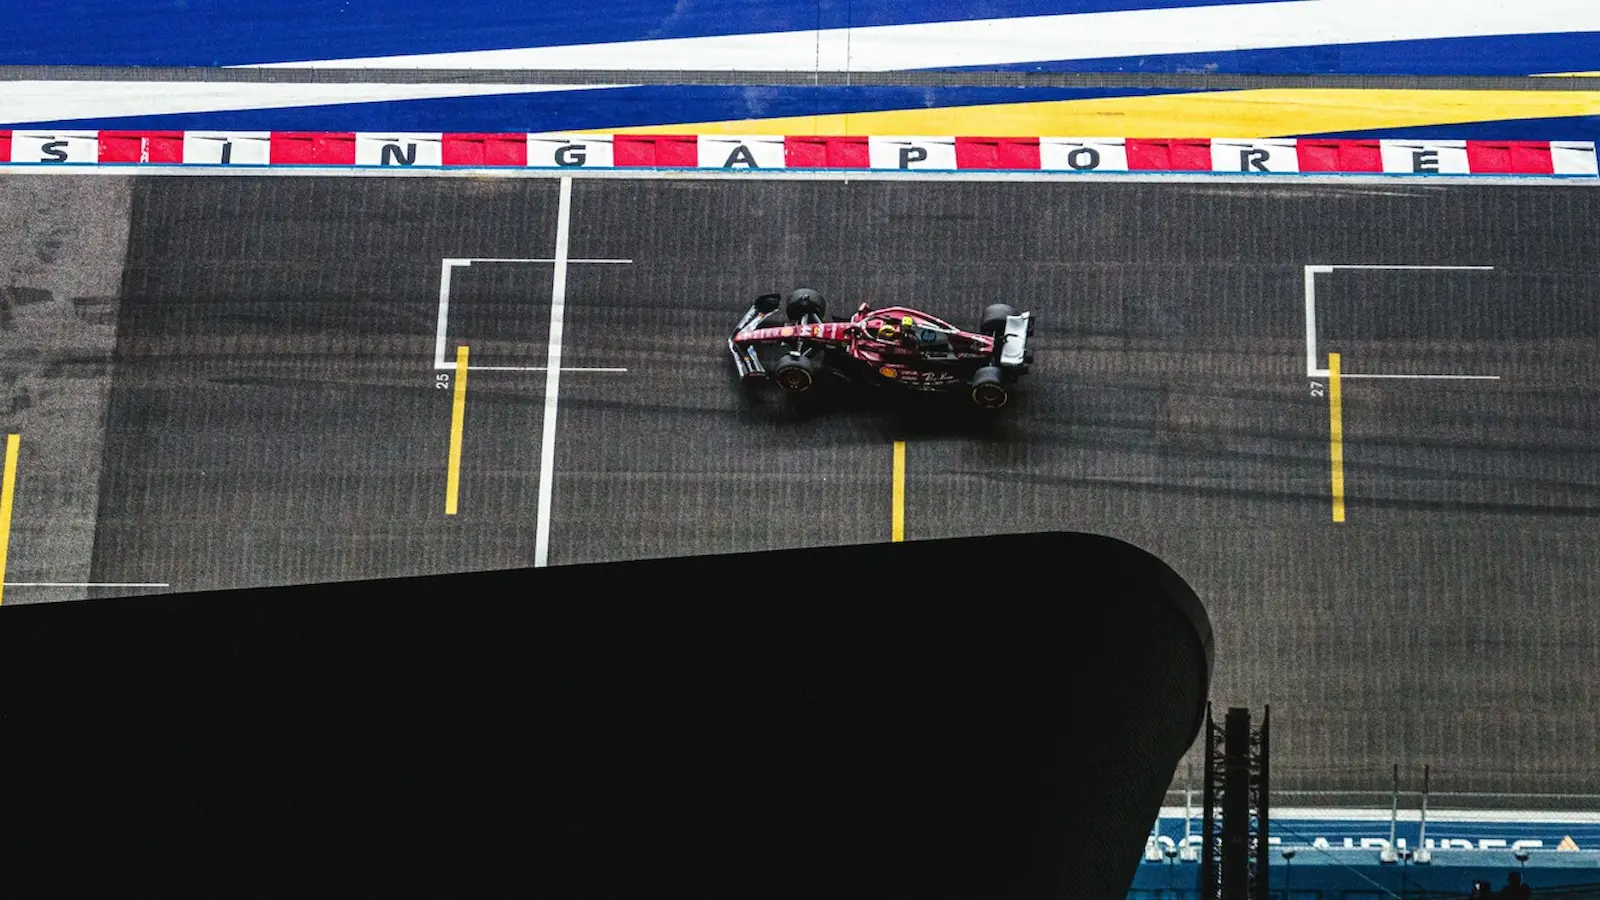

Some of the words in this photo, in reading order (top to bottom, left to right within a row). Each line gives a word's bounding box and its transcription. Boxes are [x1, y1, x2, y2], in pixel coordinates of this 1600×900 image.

[41, 141, 1439, 173] SINGAPORE
[922, 330, 936, 342] hp
[436, 374, 449, 389] 25
[1311, 381, 1324, 397] 27
